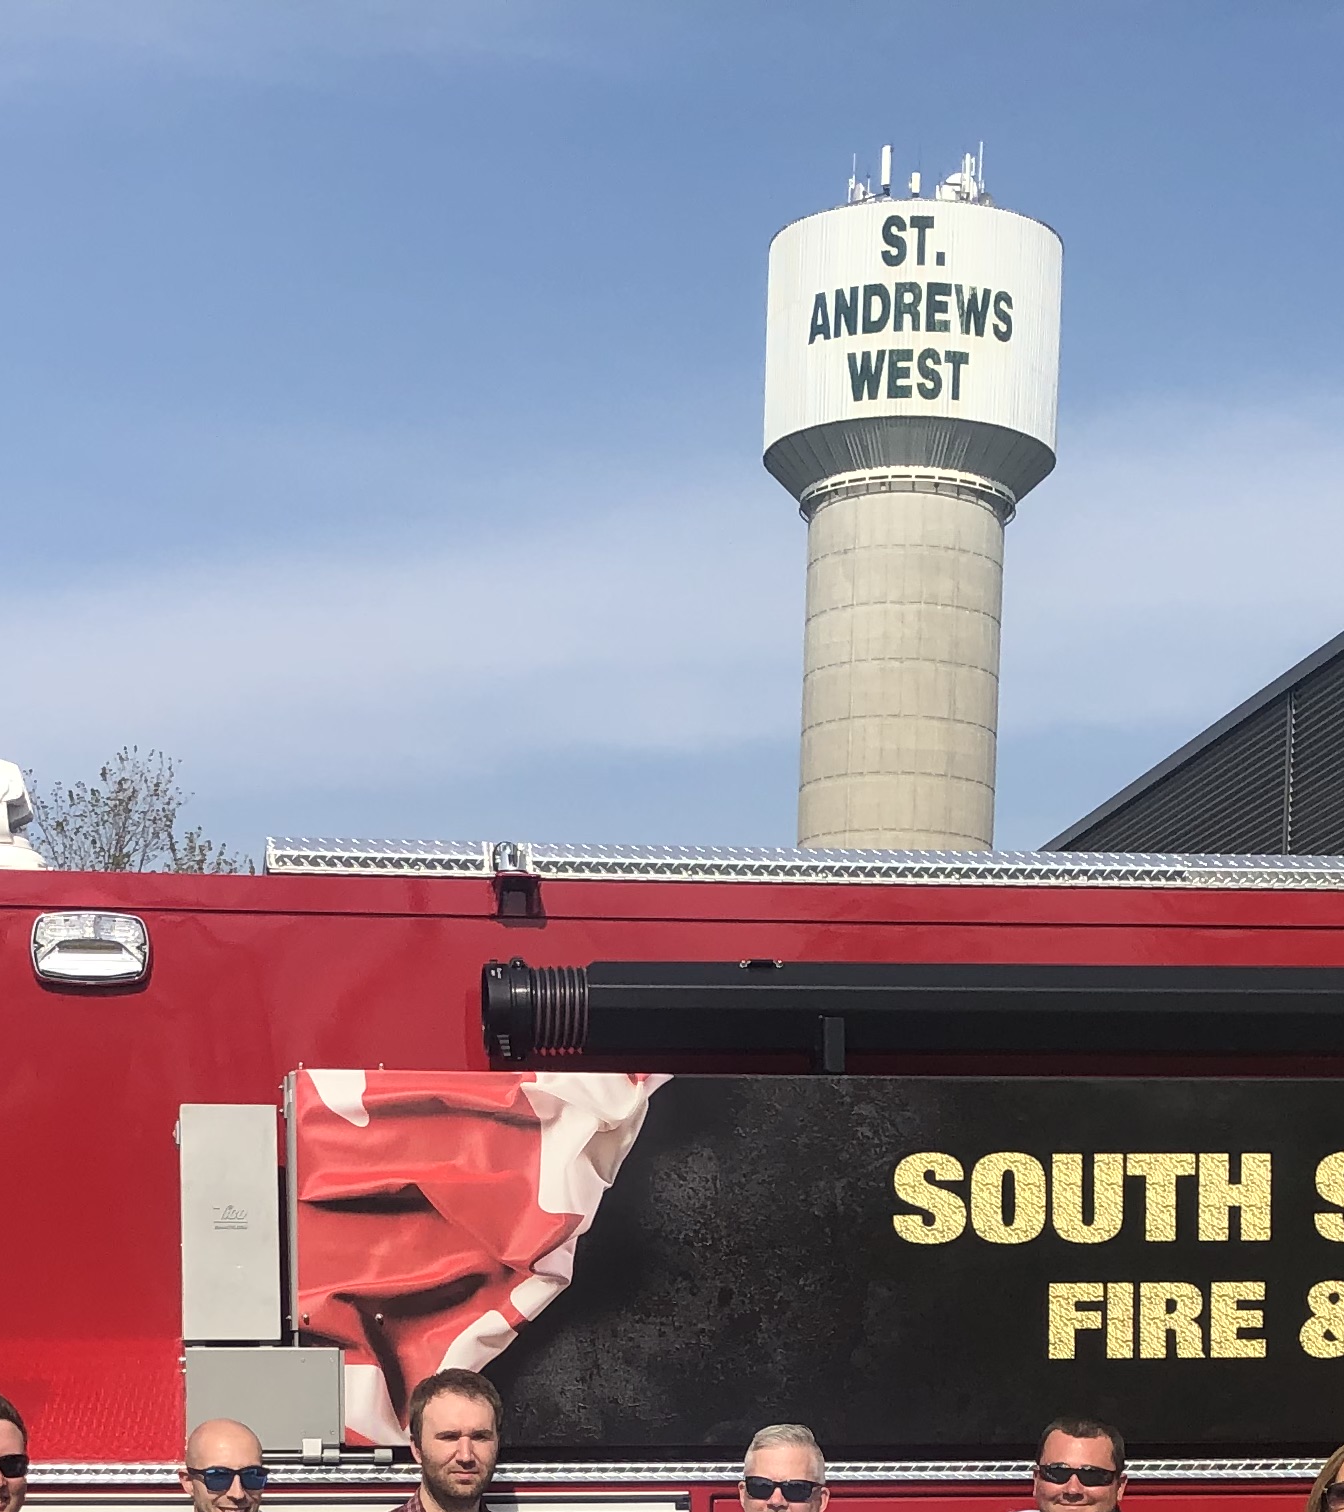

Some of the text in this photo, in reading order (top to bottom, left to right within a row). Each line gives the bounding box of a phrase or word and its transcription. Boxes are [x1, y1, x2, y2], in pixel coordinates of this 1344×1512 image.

[881, 215, 946, 267] ST.
[808, 281, 1014, 345] ANDREWS
[847, 347, 970, 402] WEST
[892, 1151, 1272, 1245] SOUTH
[1048, 1281, 1267, 1360] FIRE
